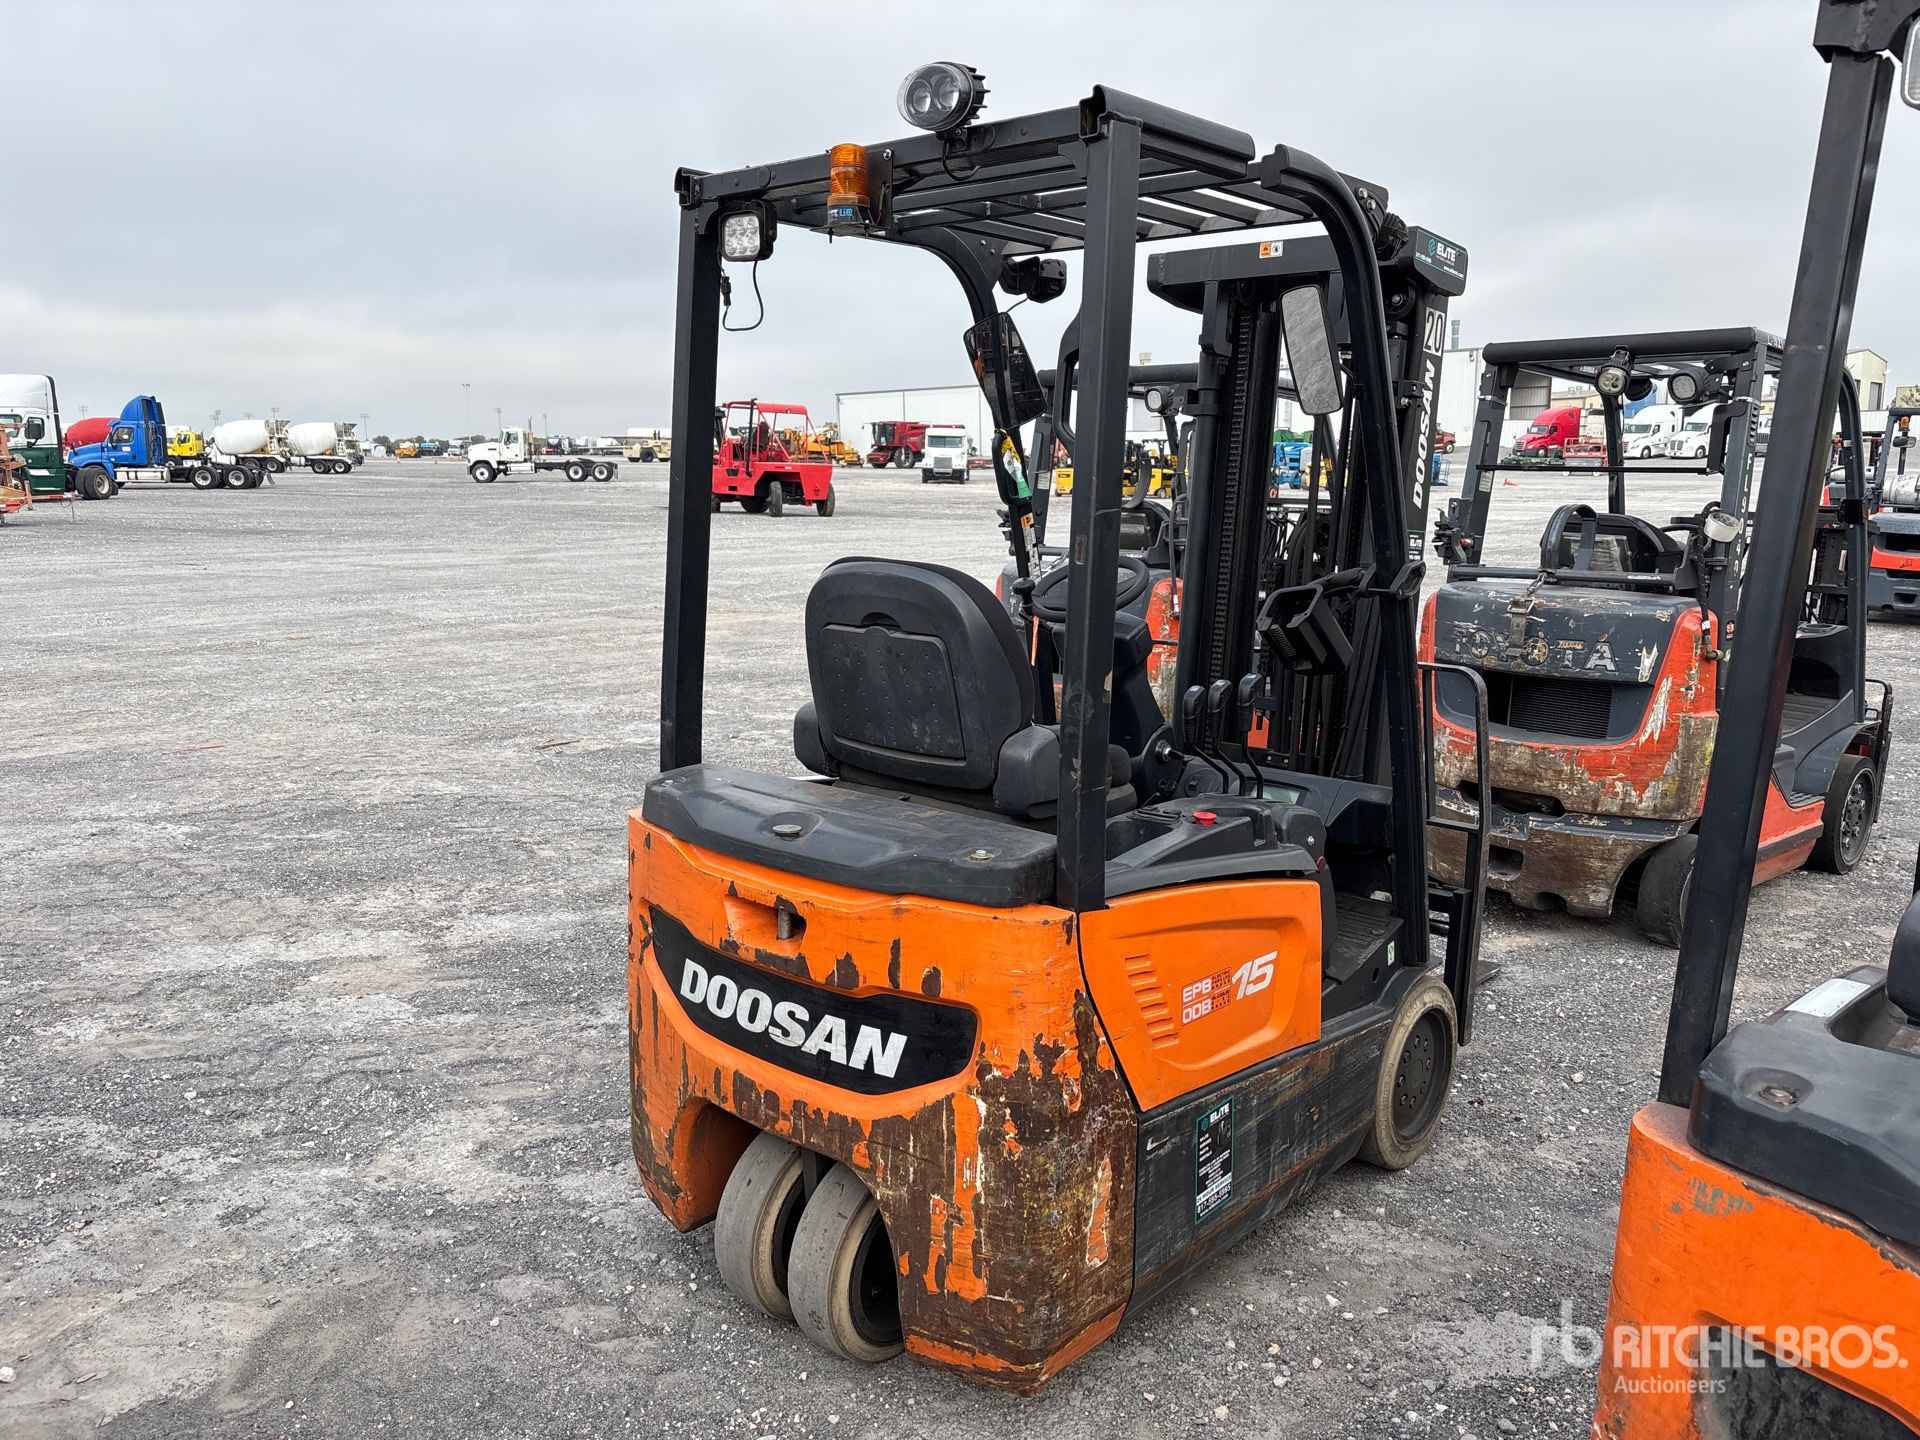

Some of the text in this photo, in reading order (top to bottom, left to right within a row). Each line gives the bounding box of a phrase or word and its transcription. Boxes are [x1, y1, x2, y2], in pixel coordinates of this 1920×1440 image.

[1436, 242, 1456, 262] ELITE
[1424, 310, 1443, 353] 20
[1412, 358, 1435, 510] DOOSAN
[1182, 978, 1212, 1003] EPB
[1231, 951, 1278, 1001] 15
[679, 957, 908, 1079] DOOSAN
[1182, 998, 1212, 1024] ODB
[1209, 1102, 1230, 1123] ELITE
